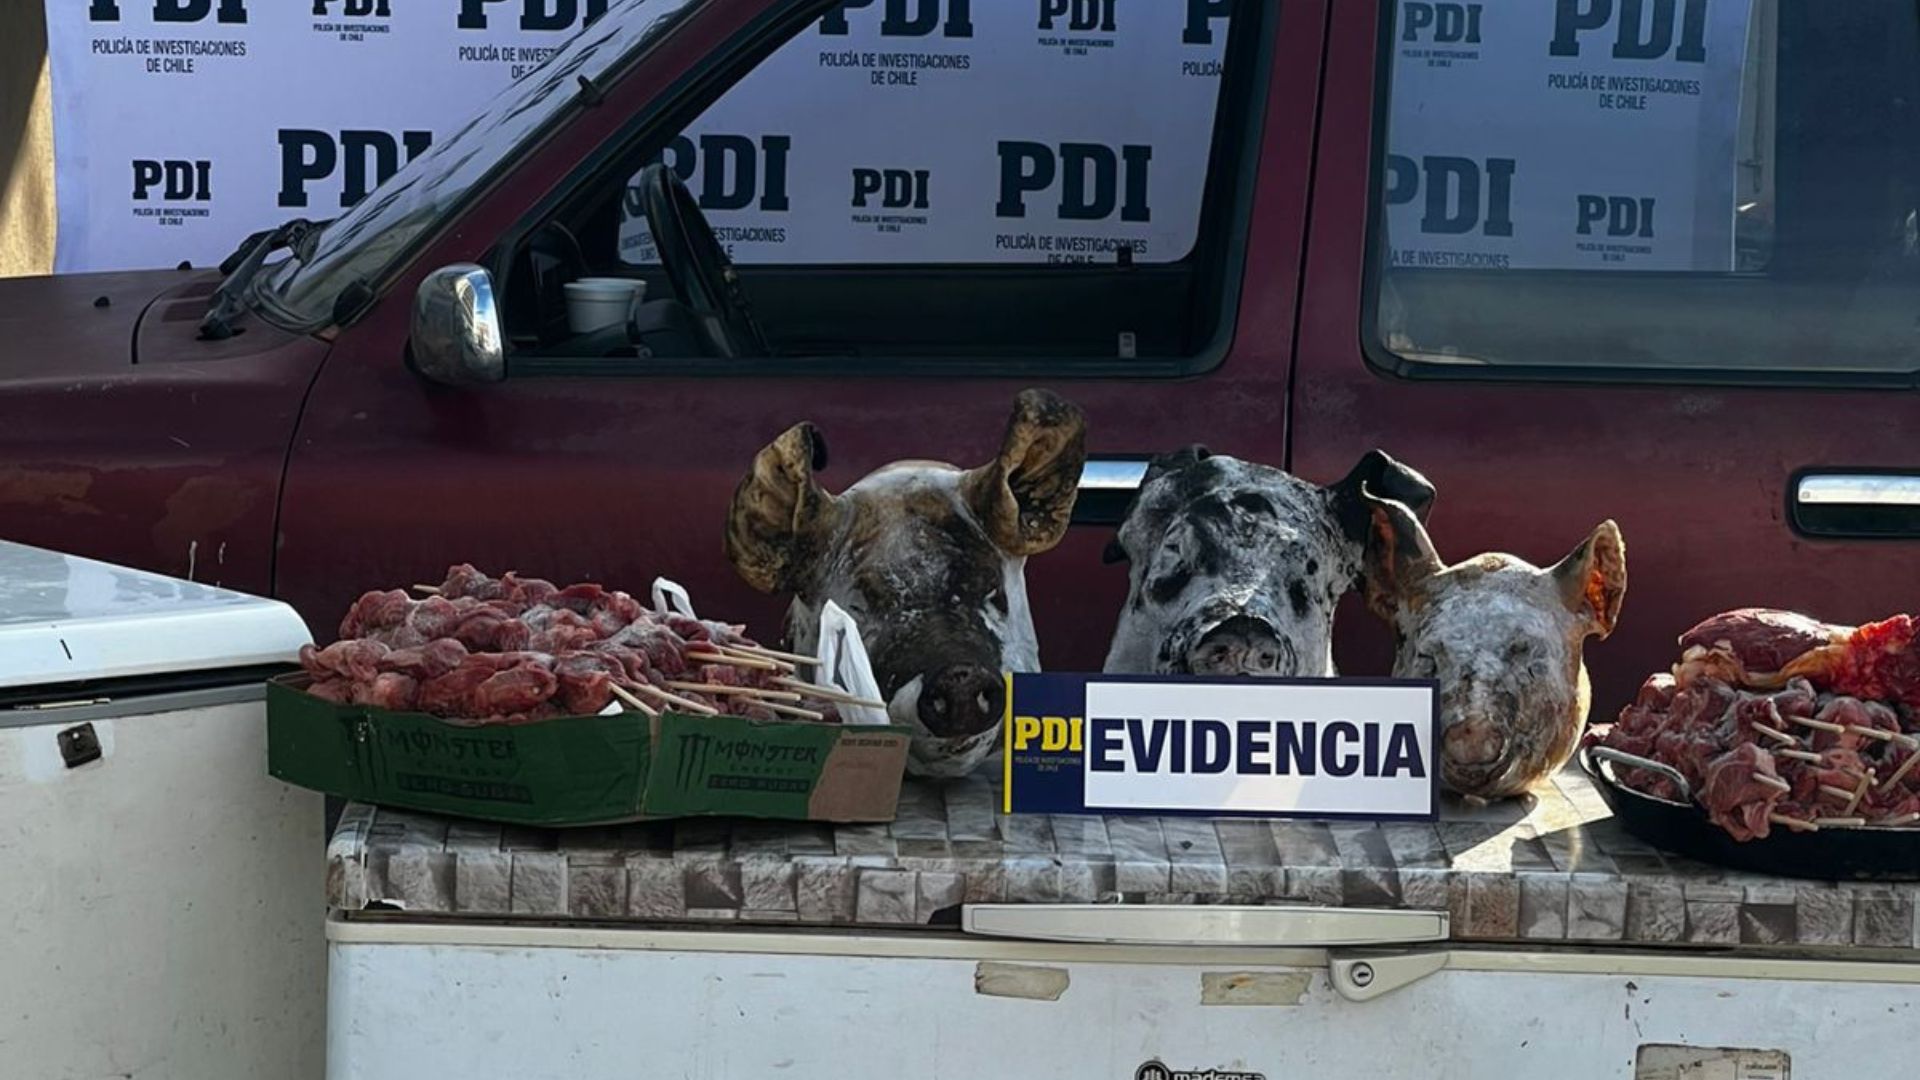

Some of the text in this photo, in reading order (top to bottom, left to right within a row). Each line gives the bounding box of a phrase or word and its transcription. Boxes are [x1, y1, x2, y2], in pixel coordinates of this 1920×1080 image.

[1038, 0, 1116, 32] PDI
[1403, 2, 1482, 43] PDI
[1550, 0, 1706, 63] PDI
[92, 37, 246, 56] POLICÍA DE INVESTIGACIONES
[459, 44, 499, 61] POLICÍA
[502, 47, 516, 61] DE
[146, 58, 194, 73] DE CHILE
[819, 50, 970, 69] POLICÍA DE INVESTIGACIONES
[871, 71, 917, 86] DE CHILE
[1548, 72, 1700, 95] POLICÍA DE INVESTIGACIONES
[1600, 94, 1647, 110] DE CHILE
[132, 160, 211, 200] PDI
[852, 168, 930, 209] PDI
[996, 141, 1152, 222] PDI
[1576, 195, 1655, 238] PDI
[711, 227, 785, 243] ESTIGACIONES
[996, 233, 1036, 250] POLICÍA
[1039, 236, 1053, 250] DE
[1402, 250, 1415, 264] DE
[1014, 716, 1083, 751] PDI
[714, 739, 817, 764] MONSTER
[1090, 718, 1426, 778] EVIDENCIA
